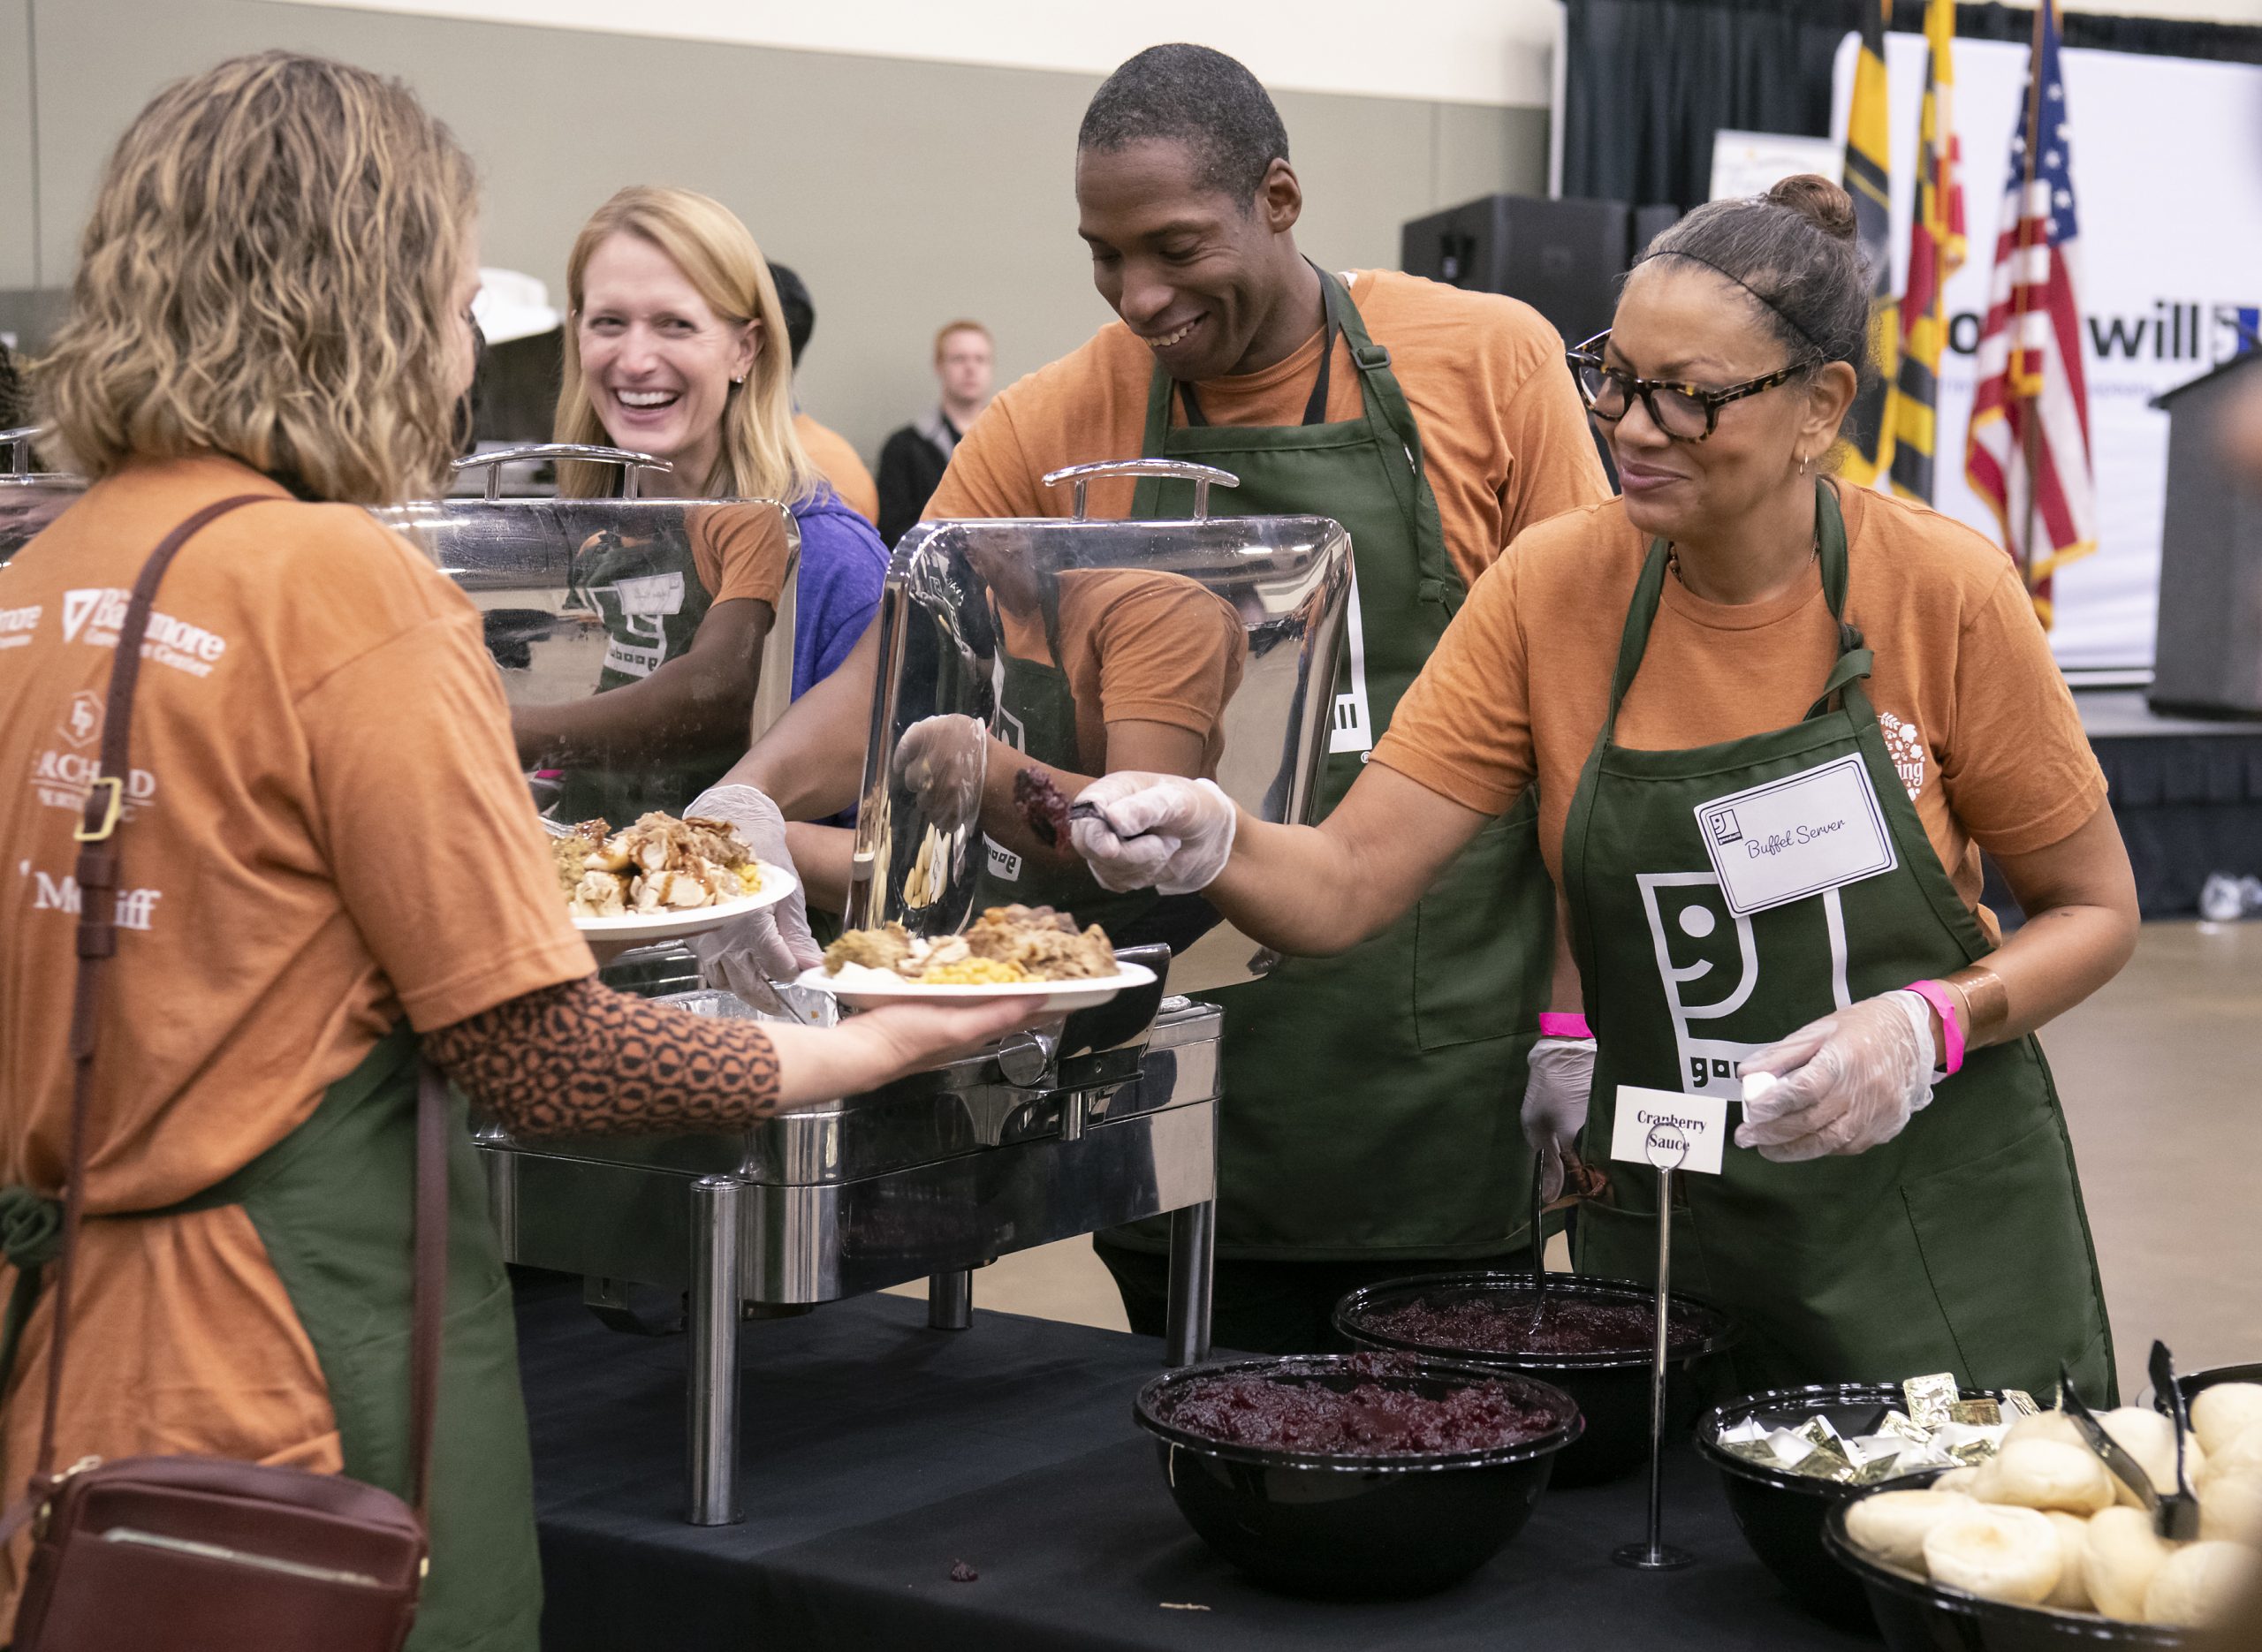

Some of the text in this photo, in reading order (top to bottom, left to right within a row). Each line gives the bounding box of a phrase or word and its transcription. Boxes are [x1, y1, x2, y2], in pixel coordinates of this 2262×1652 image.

[1745, 830, 1795, 859] Buffet
[1796, 819, 1846, 845] Server
[1637, 1110, 1707, 1134] Cranberry
[1648, 1133, 1690, 1152] Sauce
